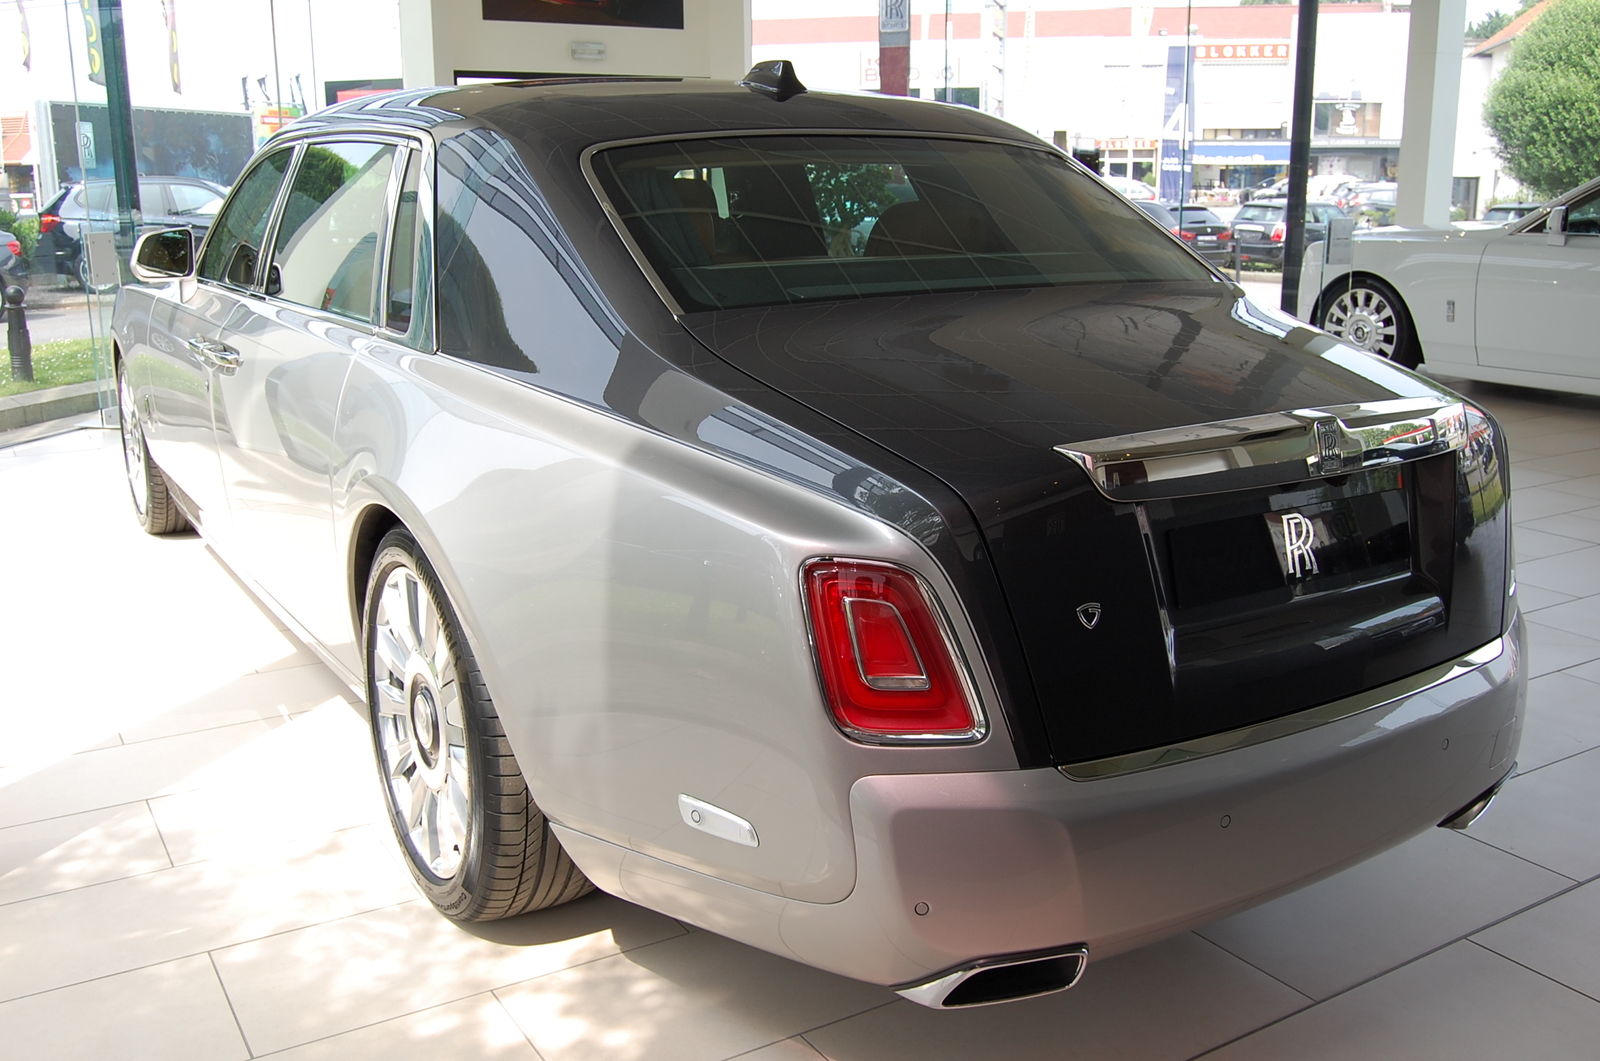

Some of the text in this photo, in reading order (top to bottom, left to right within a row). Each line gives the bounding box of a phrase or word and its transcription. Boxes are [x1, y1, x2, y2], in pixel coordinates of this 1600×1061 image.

[1195, 45, 1288, 58] BLOKKER
[1161, 102, 1194, 151] 4
[1281, 512, 1320, 578] RR
